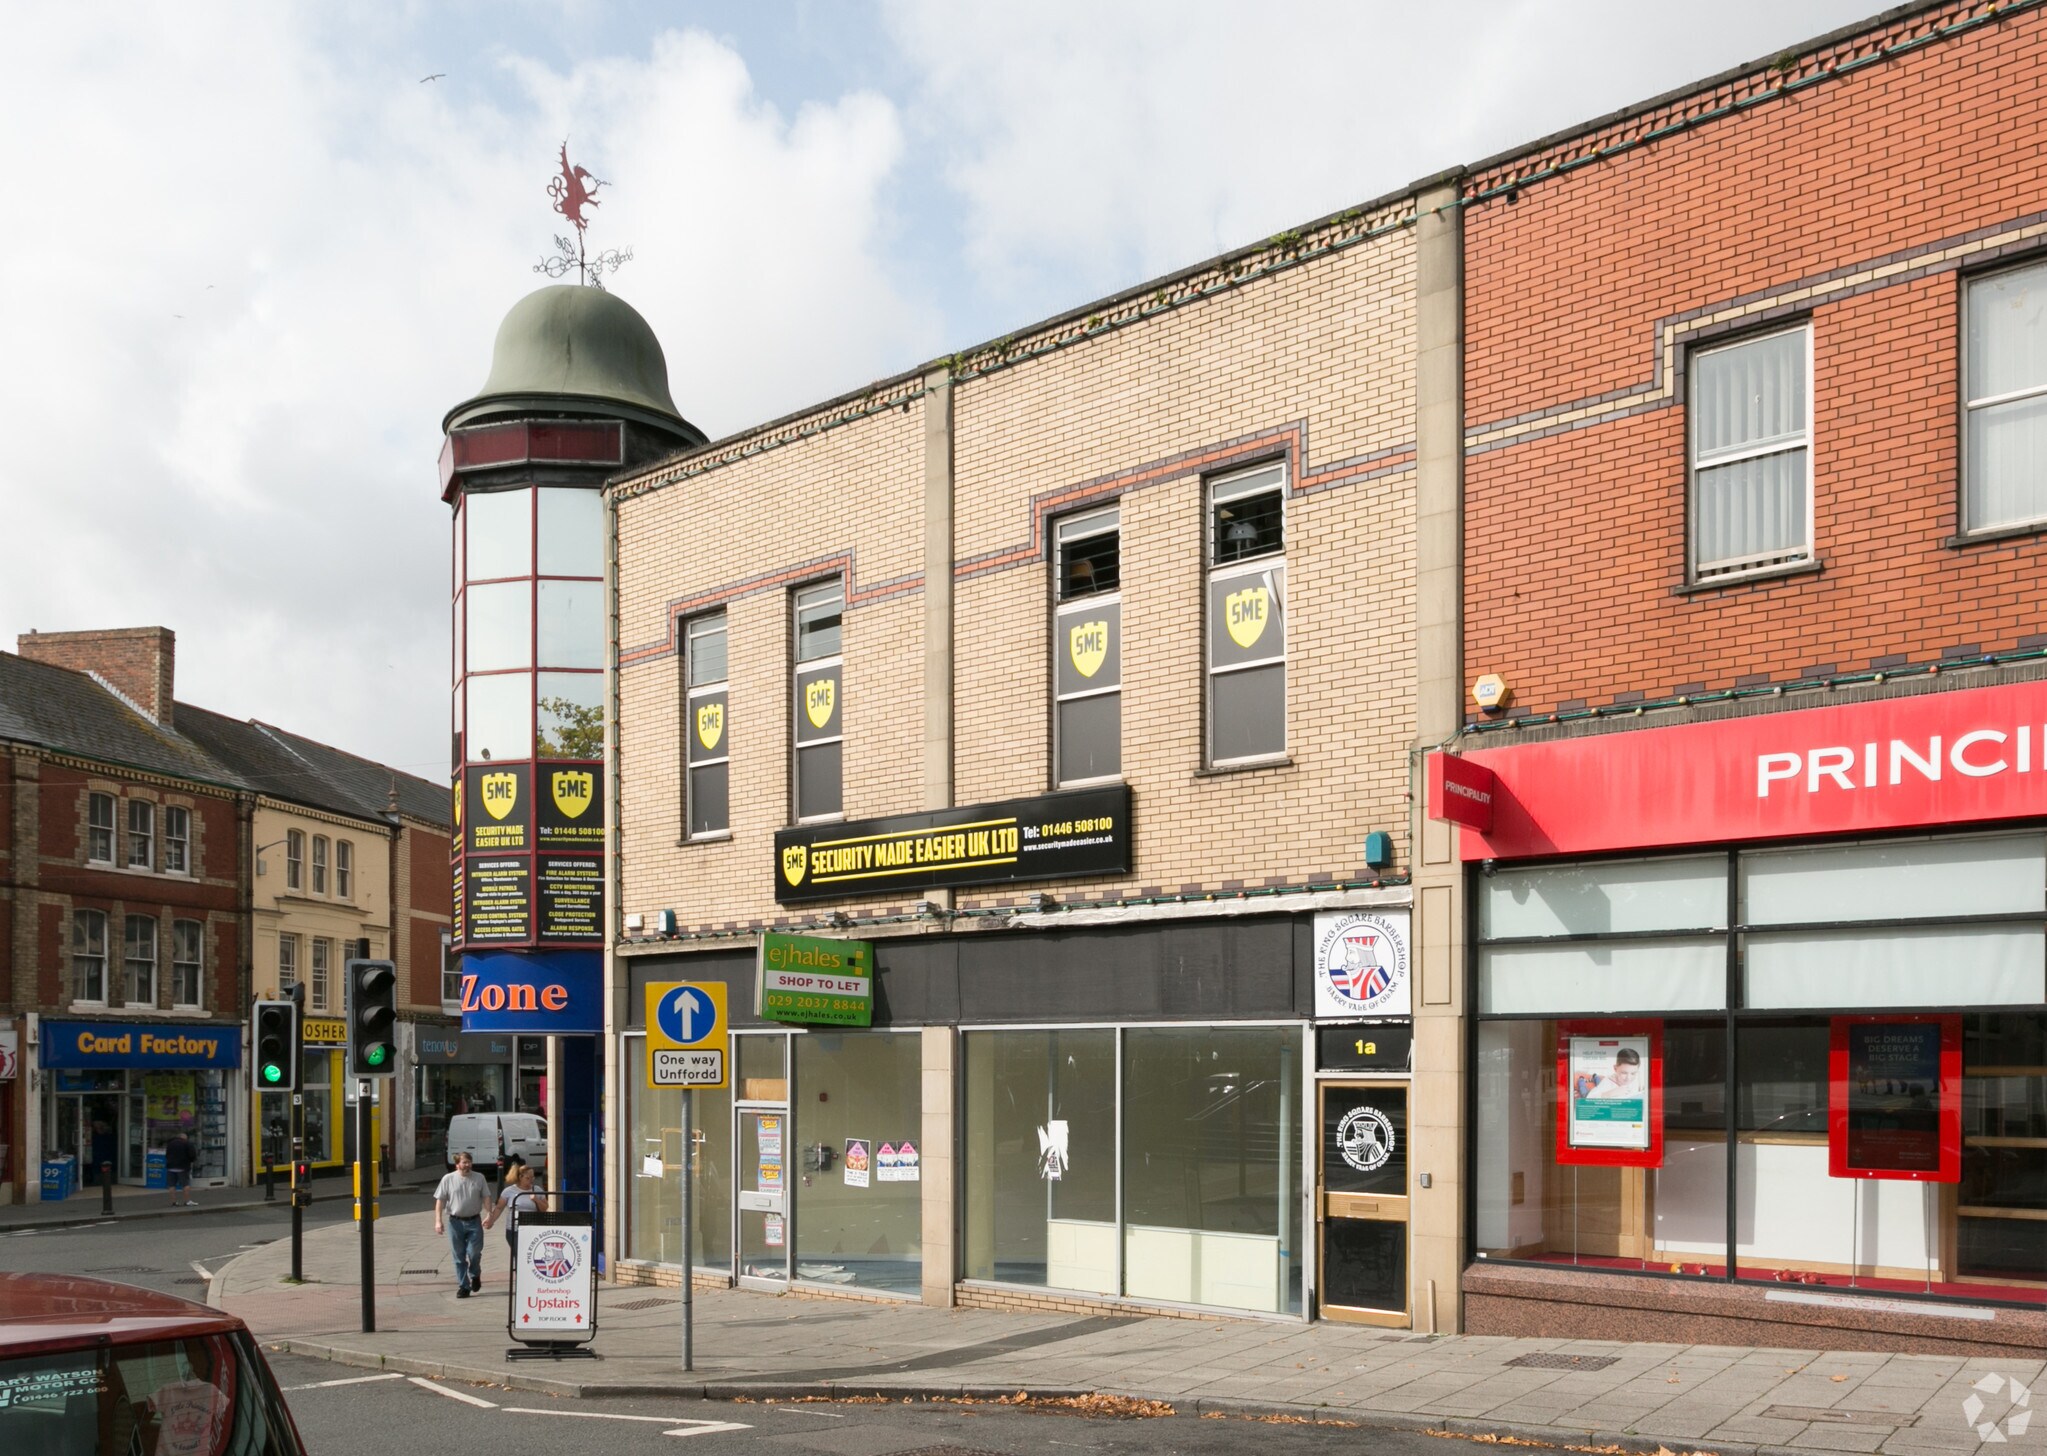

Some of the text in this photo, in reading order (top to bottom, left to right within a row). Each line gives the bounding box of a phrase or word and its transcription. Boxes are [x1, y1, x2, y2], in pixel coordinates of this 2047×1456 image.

[1232, 598, 1262, 625] SME
[1075, 631, 1102, 656] SME
[810, 688, 830, 709] SME
[702, 712, 719, 731] SME
[1758, 723, 2047, 797] PRINCI
[487, 782, 512, 800] SME
[558, 780, 587, 798] SME
[1445, 780, 1491, 804] PRINCIPALITY
[475, 825, 523, 836] SECURITY MADE
[540, 827, 552, 835] Tel:
[554, 827, 576, 835] 01446
[1023, 817, 1112, 839] Tel: 01446 508100
[476, 836, 523, 847] EASIER UK LTD
[1023, 835, 1113, 851] www.securitymadeeasier.co.uk
[811, 827, 1018, 875] SECURITY MADE EASIER UK LTD
[787, 853, 803, 870] SME
[1318, 913, 1406, 978] THE KING SQUARE BARBERSHOP
[769, 944, 841, 969] ejhales
[779, 975, 860, 992] SHOP TO LET
[462, 974, 568, 1012] Zone
[1326, 982, 1398, 1011] BARRY VALE OF GLAM
[768, 994, 865, 1011] 029 2037 8844
[776, 1009, 856, 1020] www.ejhales.co.uk
[78, 1032, 218, 1058] Card Factory
[422, 1039, 507, 1058] tenovus Barry
[1355, 1039, 1376, 1054] 1a
[660, 1055, 716, 1067] One way
[1888, 1054, 1919, 1062] STAGE
[660, 1069, 716, 1079] Unffordd
[362, 1085, 368, 1094] 4
[1347, 1106, 1374, 1120] SQUARE
[528, 1296, 580, 1311] Upstairs
[36, 1369, 103, 1382] WATSON
[15, 1377, 104, 1393] MOTOR CO.
[21, 1392, 58, 1402] 01446
[62, 1389, 84, 1397] 722
